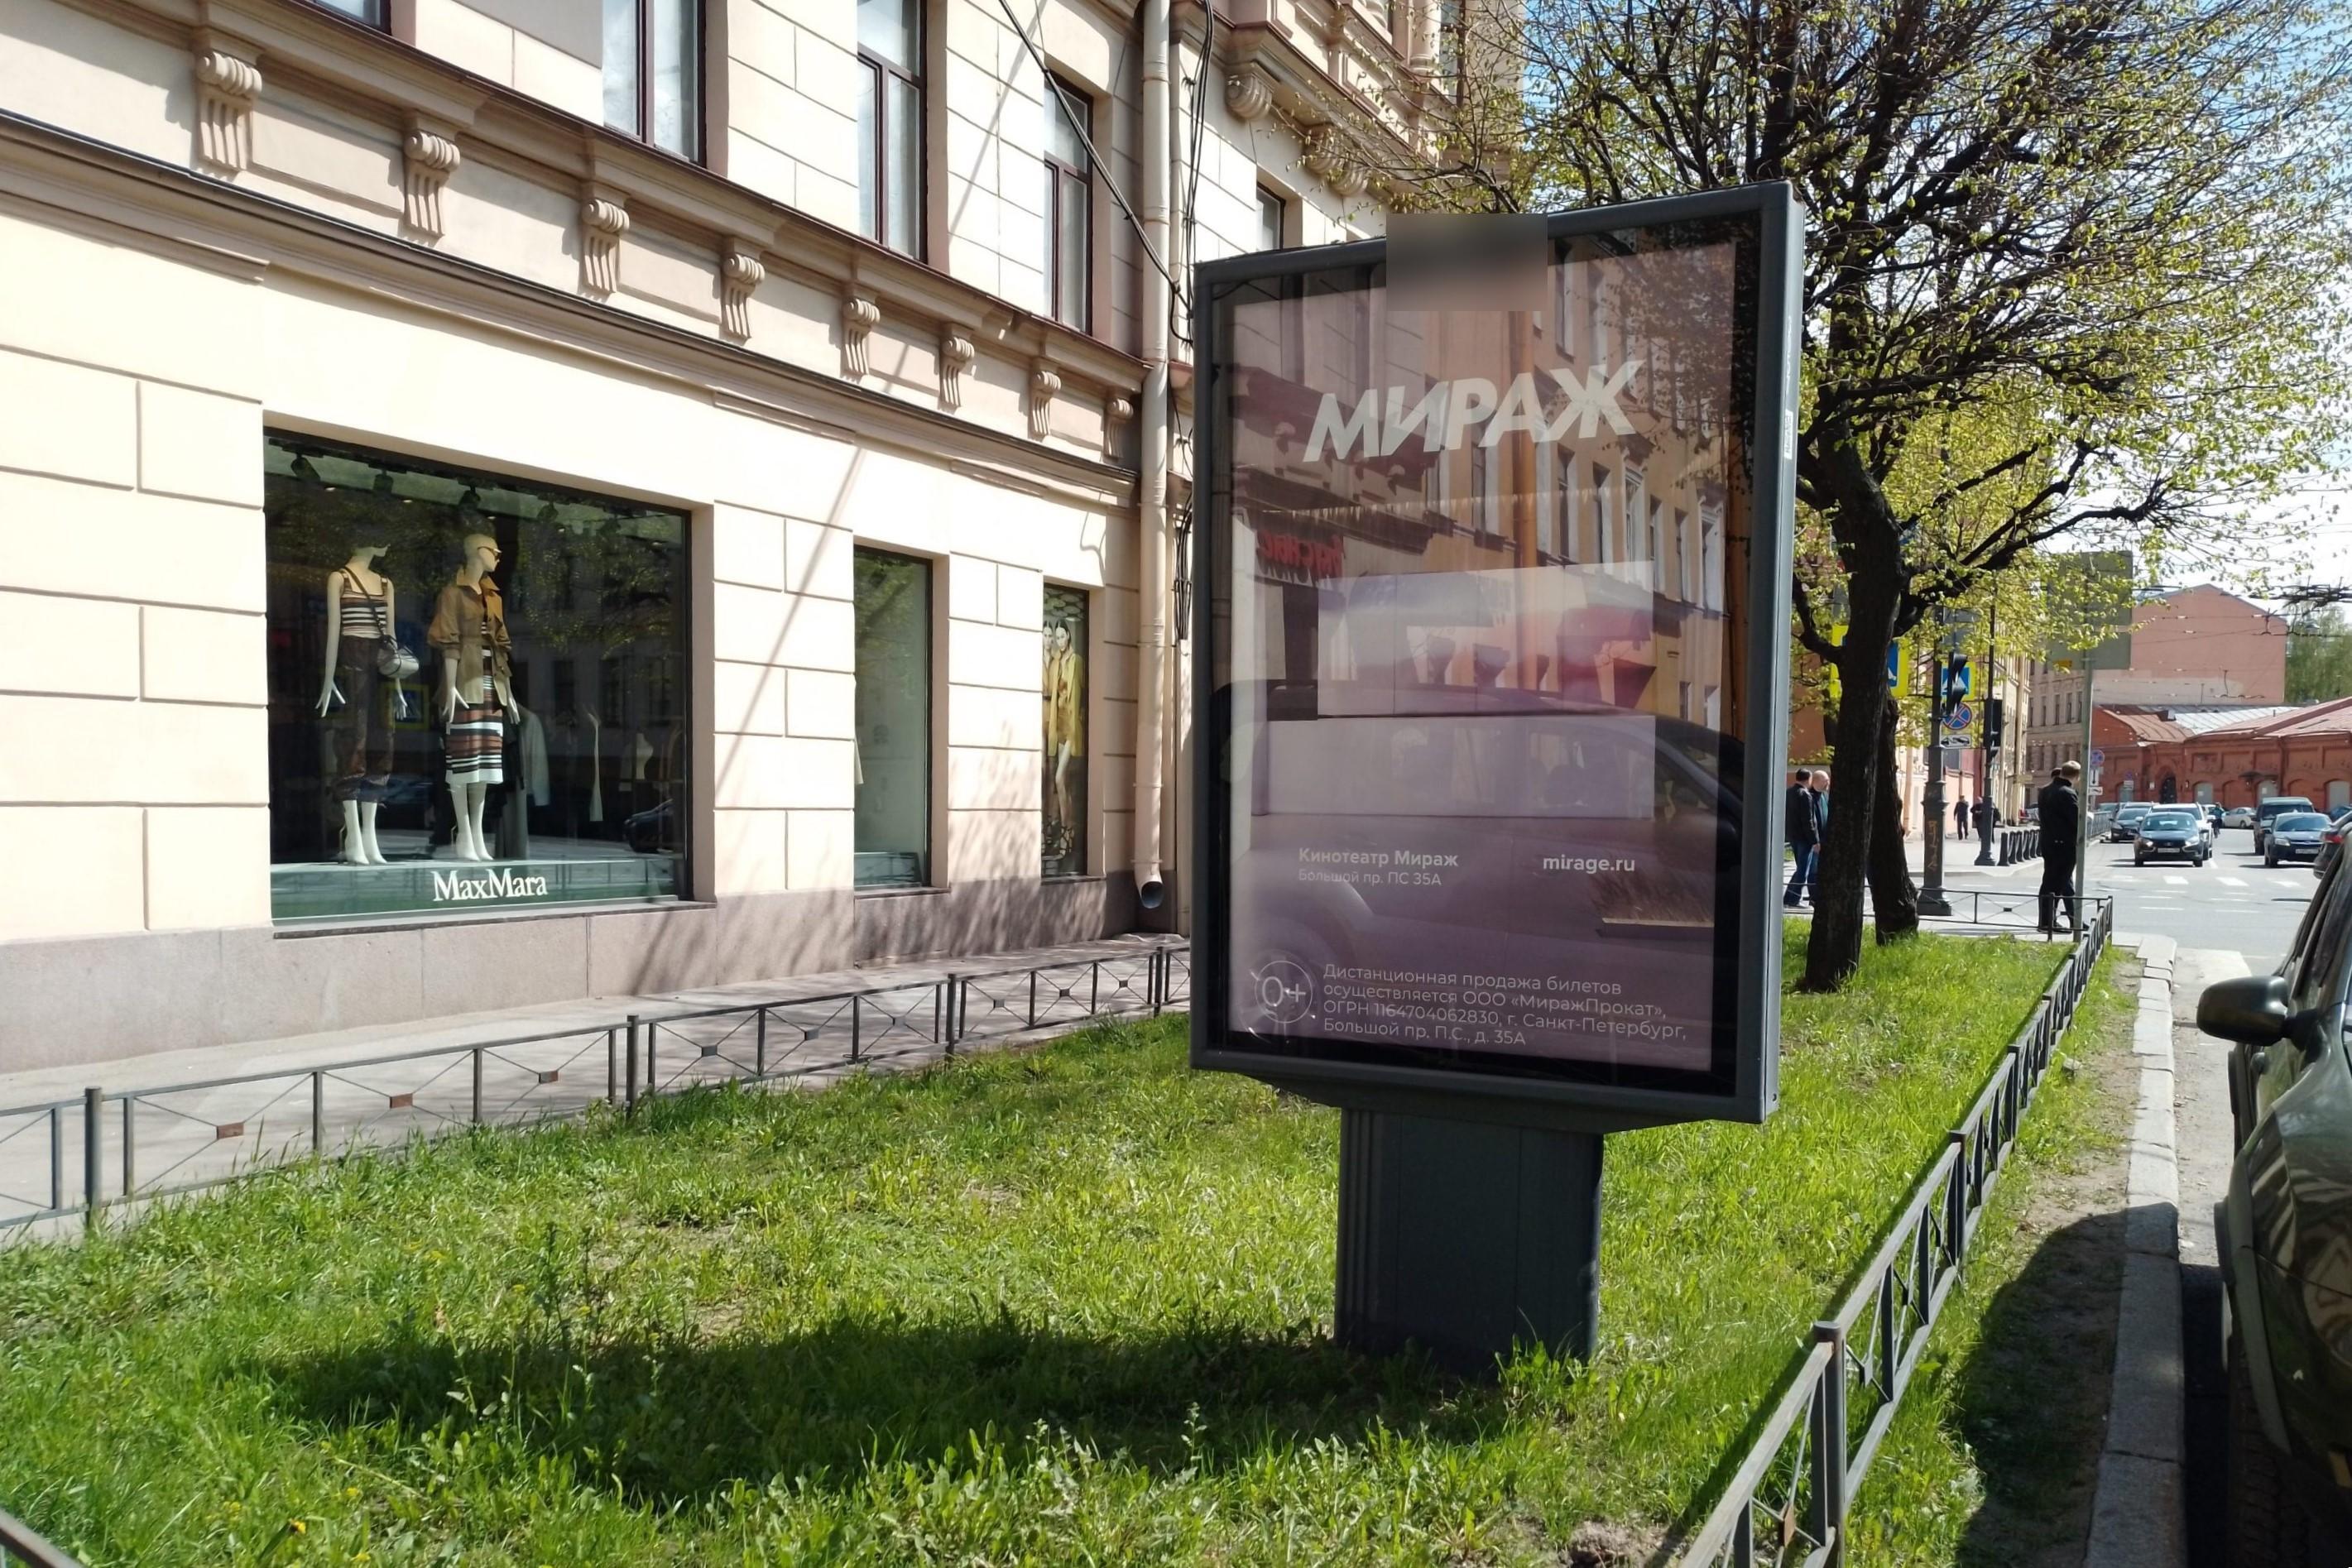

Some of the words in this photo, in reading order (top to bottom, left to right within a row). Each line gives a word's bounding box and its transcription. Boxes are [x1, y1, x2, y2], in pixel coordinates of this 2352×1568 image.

[1303, 359, 1646, 463] МИРАЖ
[1298, 847, 1390, 867] Кинотеатр
[1394, 850, 1459, 869] Мираж
[1543, 855, 1635, 874] mirage.ru
[431, 868, 548, 901] MaxMara
[1298, 869, 1360, 883] Большой
[1363, 873, 1385, 887] пр.
[1388, 872, 1409, 885] ПС
[1413, 872, 1442, 886] 35А
[1261, 976, 1307, 1008] 0+
[1323, 964, 1457, 985] Дистанционная
[1462, 974, 1541, 990] продажа
[1546, 976, 1622, 995] билетов
[1323, 985, 1458, 1004] осуществляется
[1462, 990, 1507, 1007] ООО
[1511, 994, 1668, 1019] «МиражПрокат»,
[1323, 1000, 1369, 1016] ОГРН
[1372, 1003, 1503, 1027] 1164704062830,
[1507, 1014, 1519, 1027] г.
[1523, 1013, 1687, 1040] Санкт-Петербург,
[1323, 1018, 1400, 1035] Большой
[1405, 1026, 1430, 1040] пр.
[1475, 1031, 1490, 1044] д.
[1493, 1029, 1526, 1046] 35А
